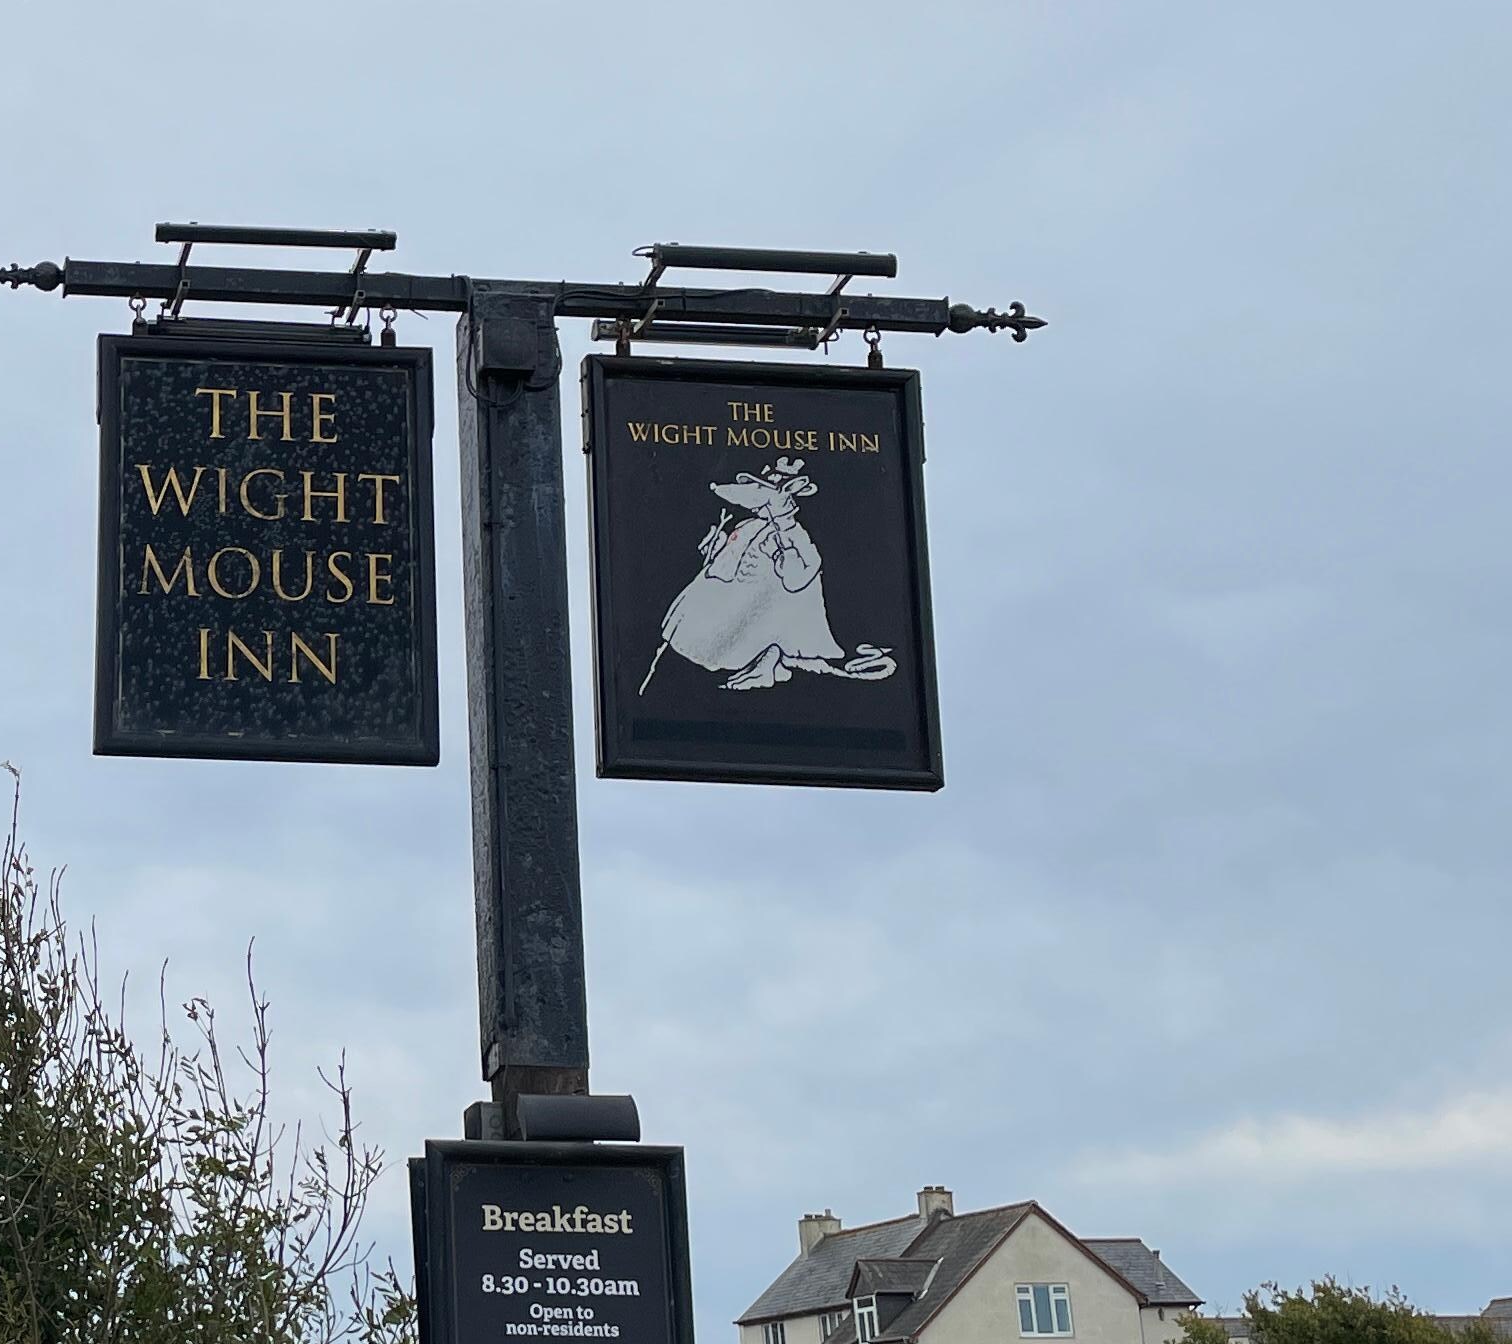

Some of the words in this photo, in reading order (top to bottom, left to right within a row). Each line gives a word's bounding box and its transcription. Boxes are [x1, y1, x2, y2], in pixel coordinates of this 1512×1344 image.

[195, 387, 338, 443] THE
[727, 401, 775, 423] THE
[627, 422, 718, 447] WIGHT
[727, 428, 818, 451] MOUSE
[828, 432, 880, 453] INN
[134, 463, 400, 525] WIGHT
[137, 543, 394, 605] MOUSE
[196, 628, 340, 686] INN
[481, 1204, 633, 1234] Breakfast
[519, 1248, 600, 1271] Served
[481, 1274, 529, 1295] 8.30
[546, 1276, 640, 1297] 10.30am
[530, 1303, 574, 1324] Open
[576, 1305, 594, 1321] to
[505, 1321, 620, 1338] non-residents
